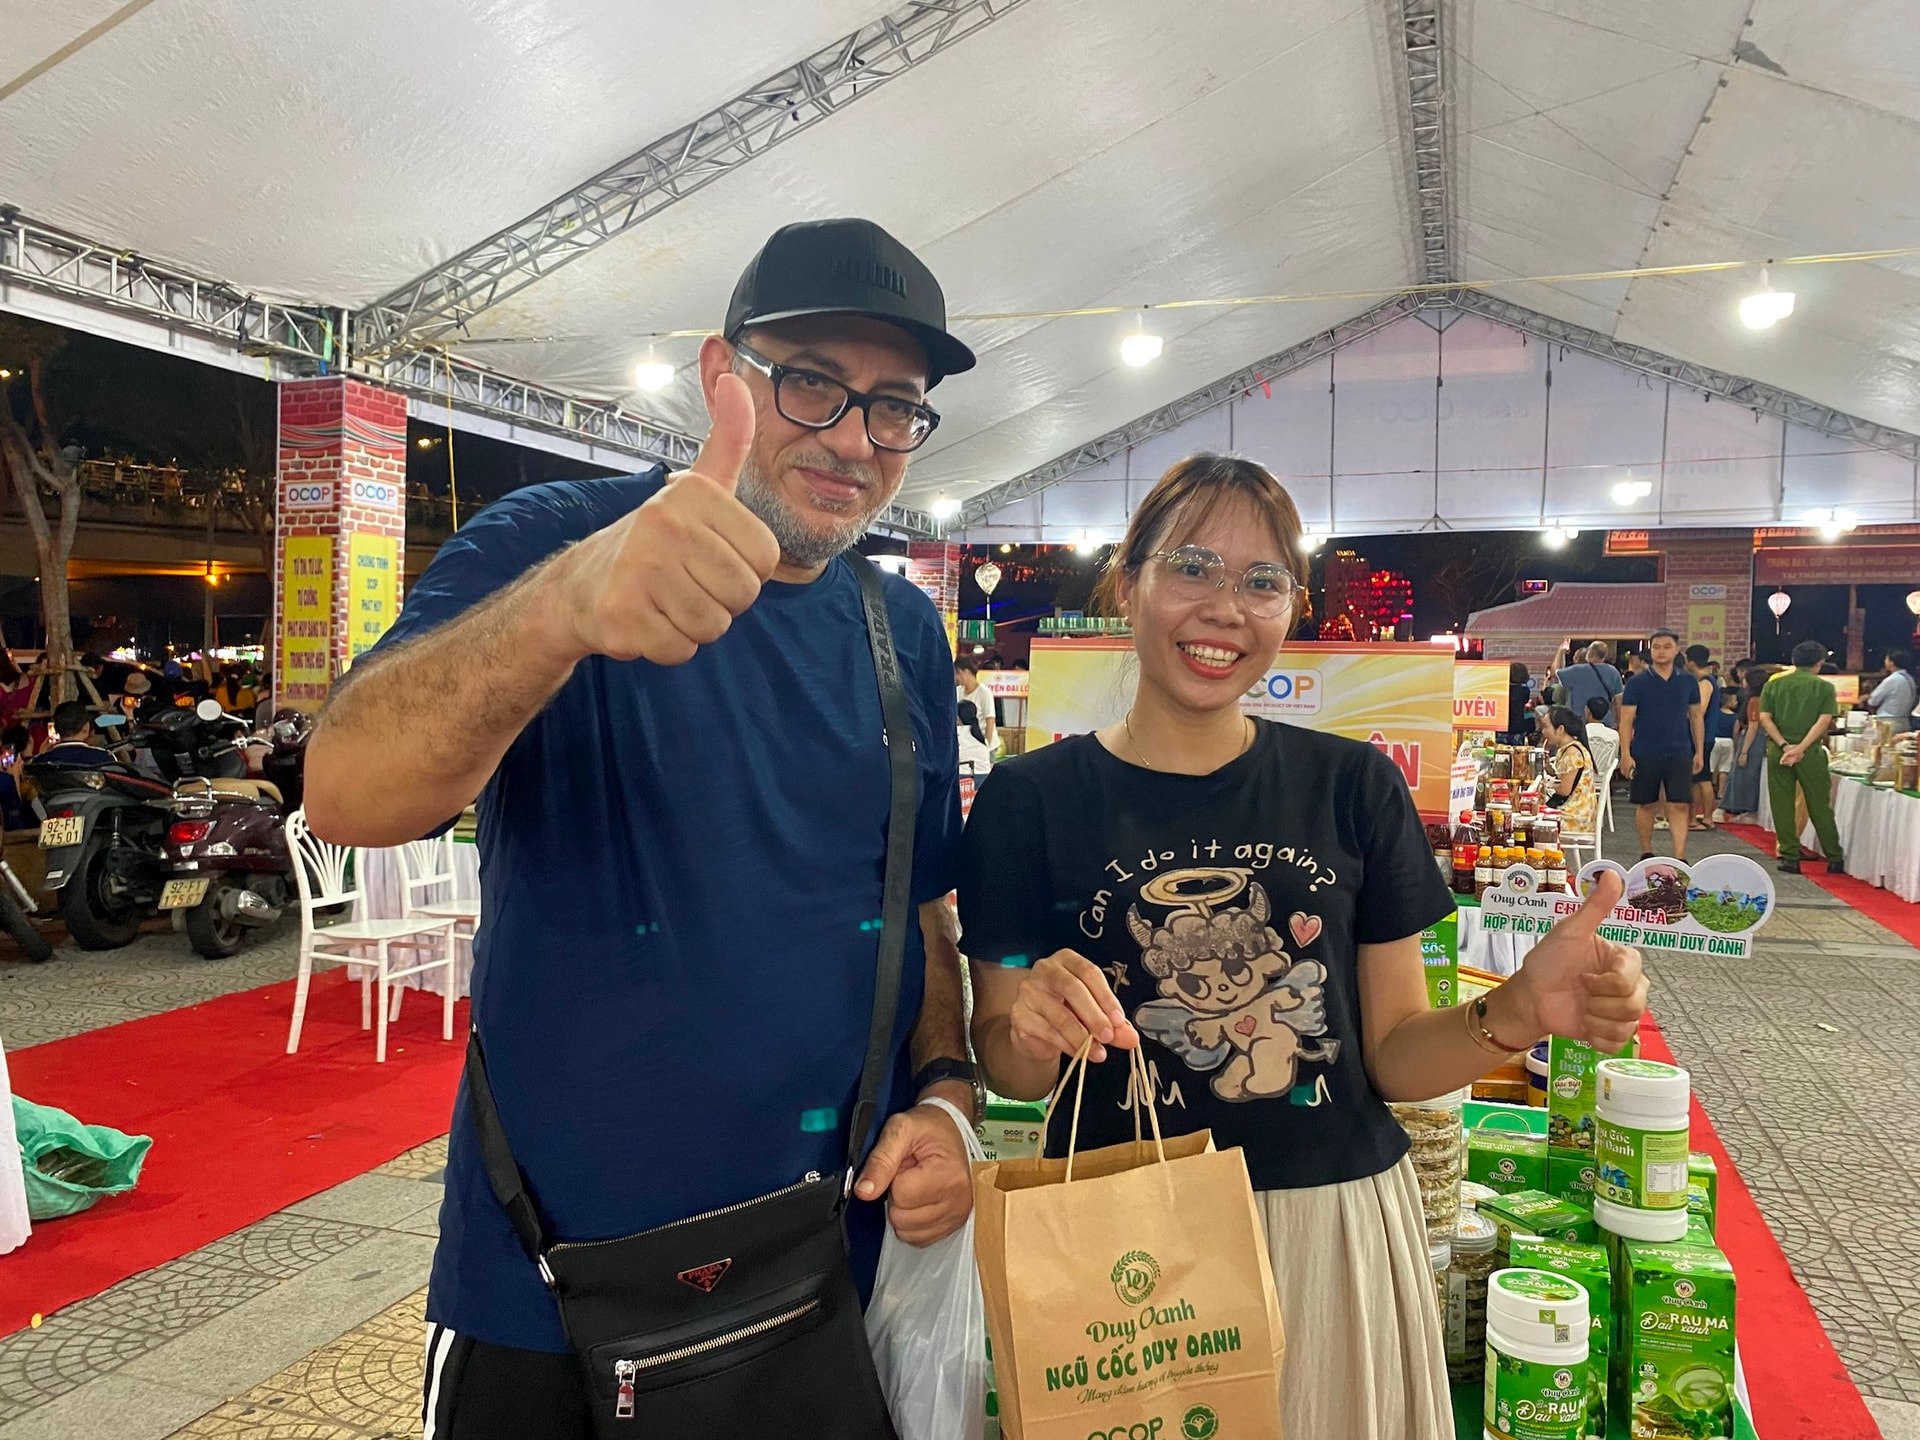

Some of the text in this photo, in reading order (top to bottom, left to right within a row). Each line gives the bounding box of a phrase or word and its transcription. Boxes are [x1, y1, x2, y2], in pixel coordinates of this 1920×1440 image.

[289, 487, 331, 502] OCOP
[354, 483, 395, 502] OCOP
[1691, 586, 1725, 595] OCOP
[1244, 674, 1315, 699] COP
[47, 817, 76, 833] 92-F1
[1079, 839, 1338, 939] Can I do it again?
[1491, 894, 1548, 908] Duy Oanh
[1484, 914, 1508, 933] HỢP
[1511, 914, 1534, 933] TÁC
[1643, 931, 1677, 949] XANH
[1679, 934, 1706, 951] DUY
[1708, 936, 1744, 956] OANH
[1424, 957, 1450, 966] anh
[1606, 1140, 1634, 1157] Oanh
[687, 1263, 723, 1280] PRADA
[1662, 1296, 1683, 1308] Duy
[1086, 1298, 1196, 1344] Duy Oanh
[1591, 1315, 1602, 1329] Á
[1671, 1313, 1701, 1327] RAU
[1046, 1326, 1242, 1392] NGŨ CỐC DUY OANH
[1541, 1388, 1562, 1399] Duy
[1548, 1401, 1577, 1414] RAU
